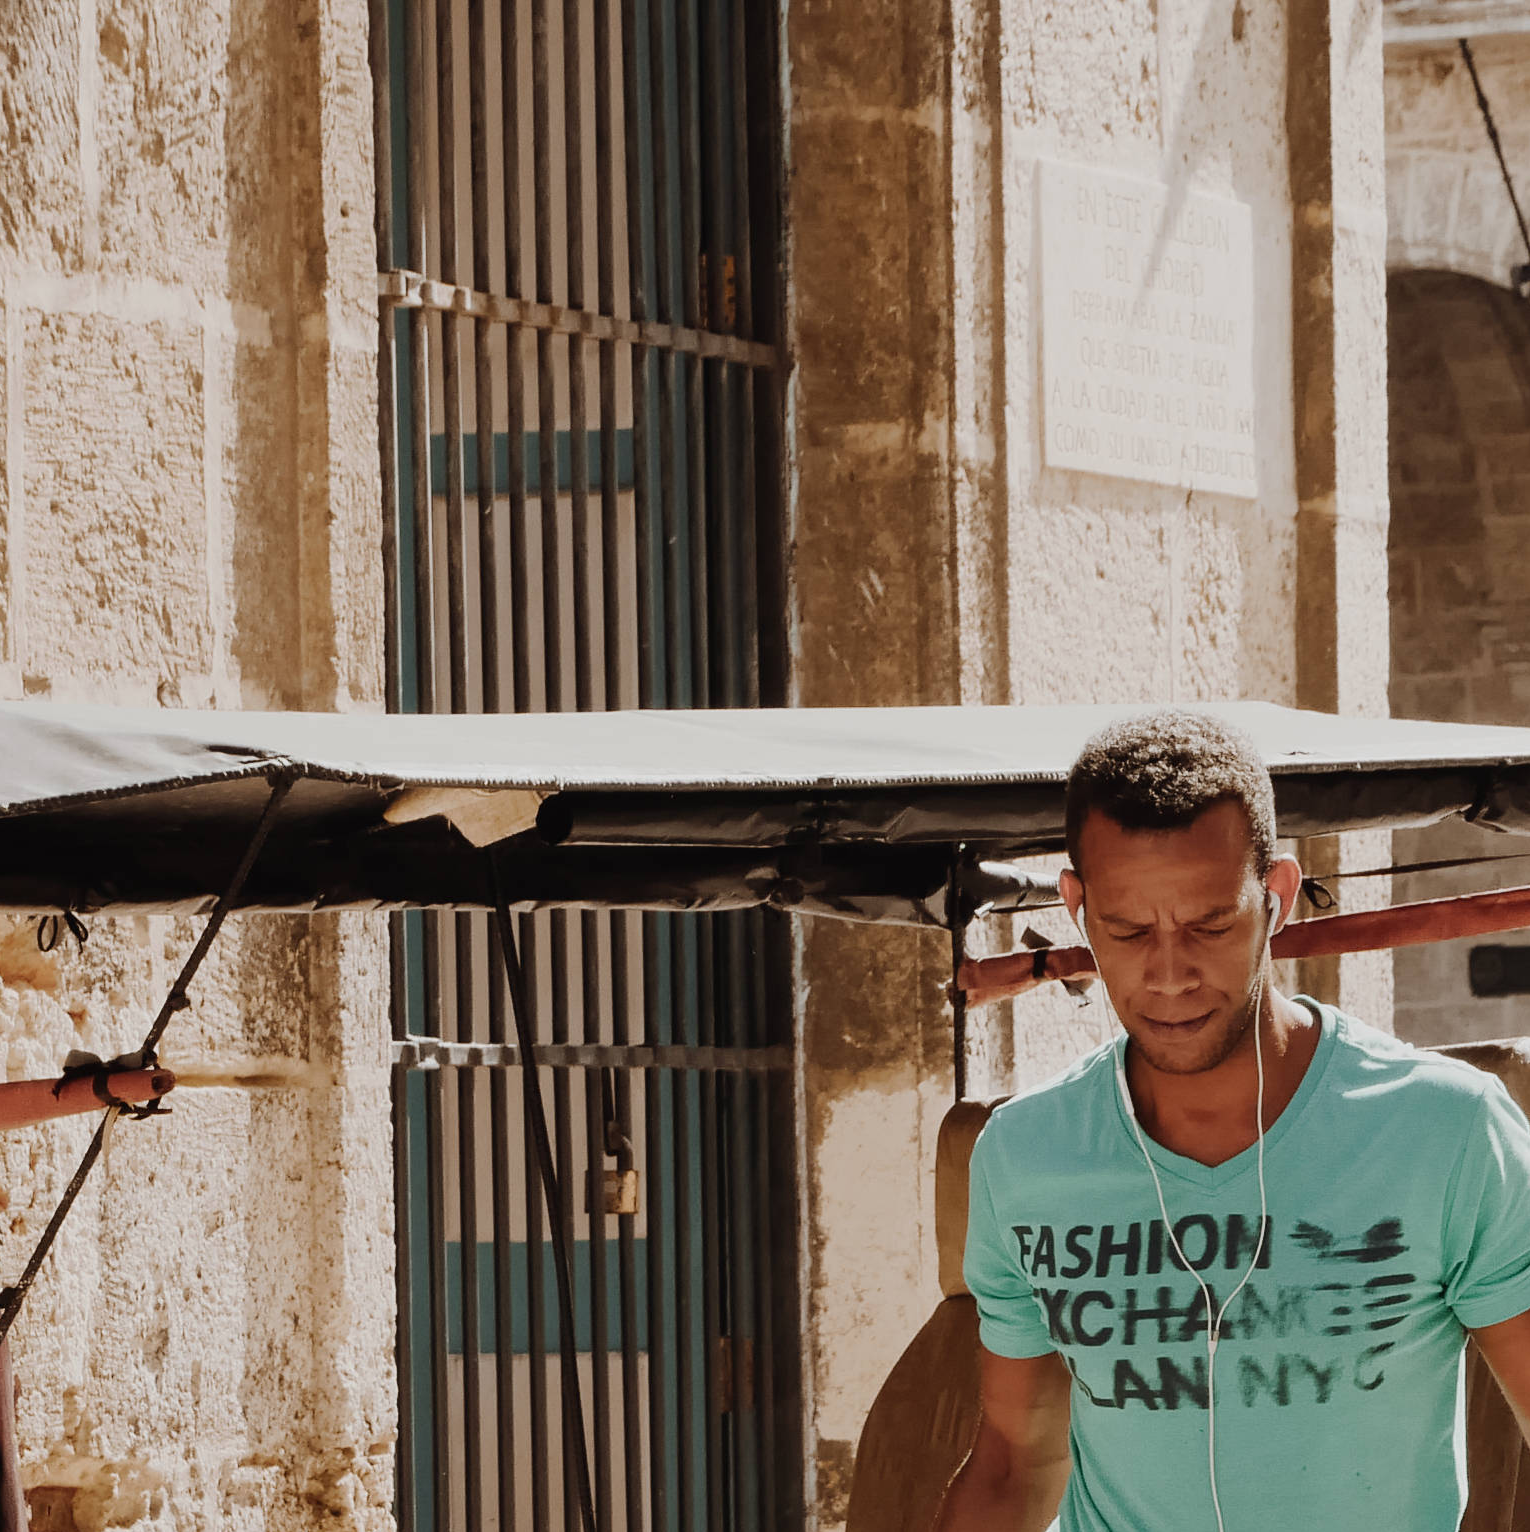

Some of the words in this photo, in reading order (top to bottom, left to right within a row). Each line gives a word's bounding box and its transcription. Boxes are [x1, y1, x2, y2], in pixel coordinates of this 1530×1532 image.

[1076, 186, 1099, 225] EN
[1105, 191, 1143, 234] ESTE
[1149, 203, 1231, 254] CLLEJON
[1104, 244, 1133, 284] DEL
[1164, 304, 1182, 339] LA
[1080, 335, 1108, 371] QUE
[1191, 355, 1230, 390] AGUA
[1052, 376, 1065, 409] A
[1069, 379, 1091, 412] LA
[1098, 384, 1149, 423] CIUDAD
[1054, 422, 1100, 456] COMO
[1107, 430, 1125, 461] SU
[1011, 1212, 1273, 1279] FASHION
